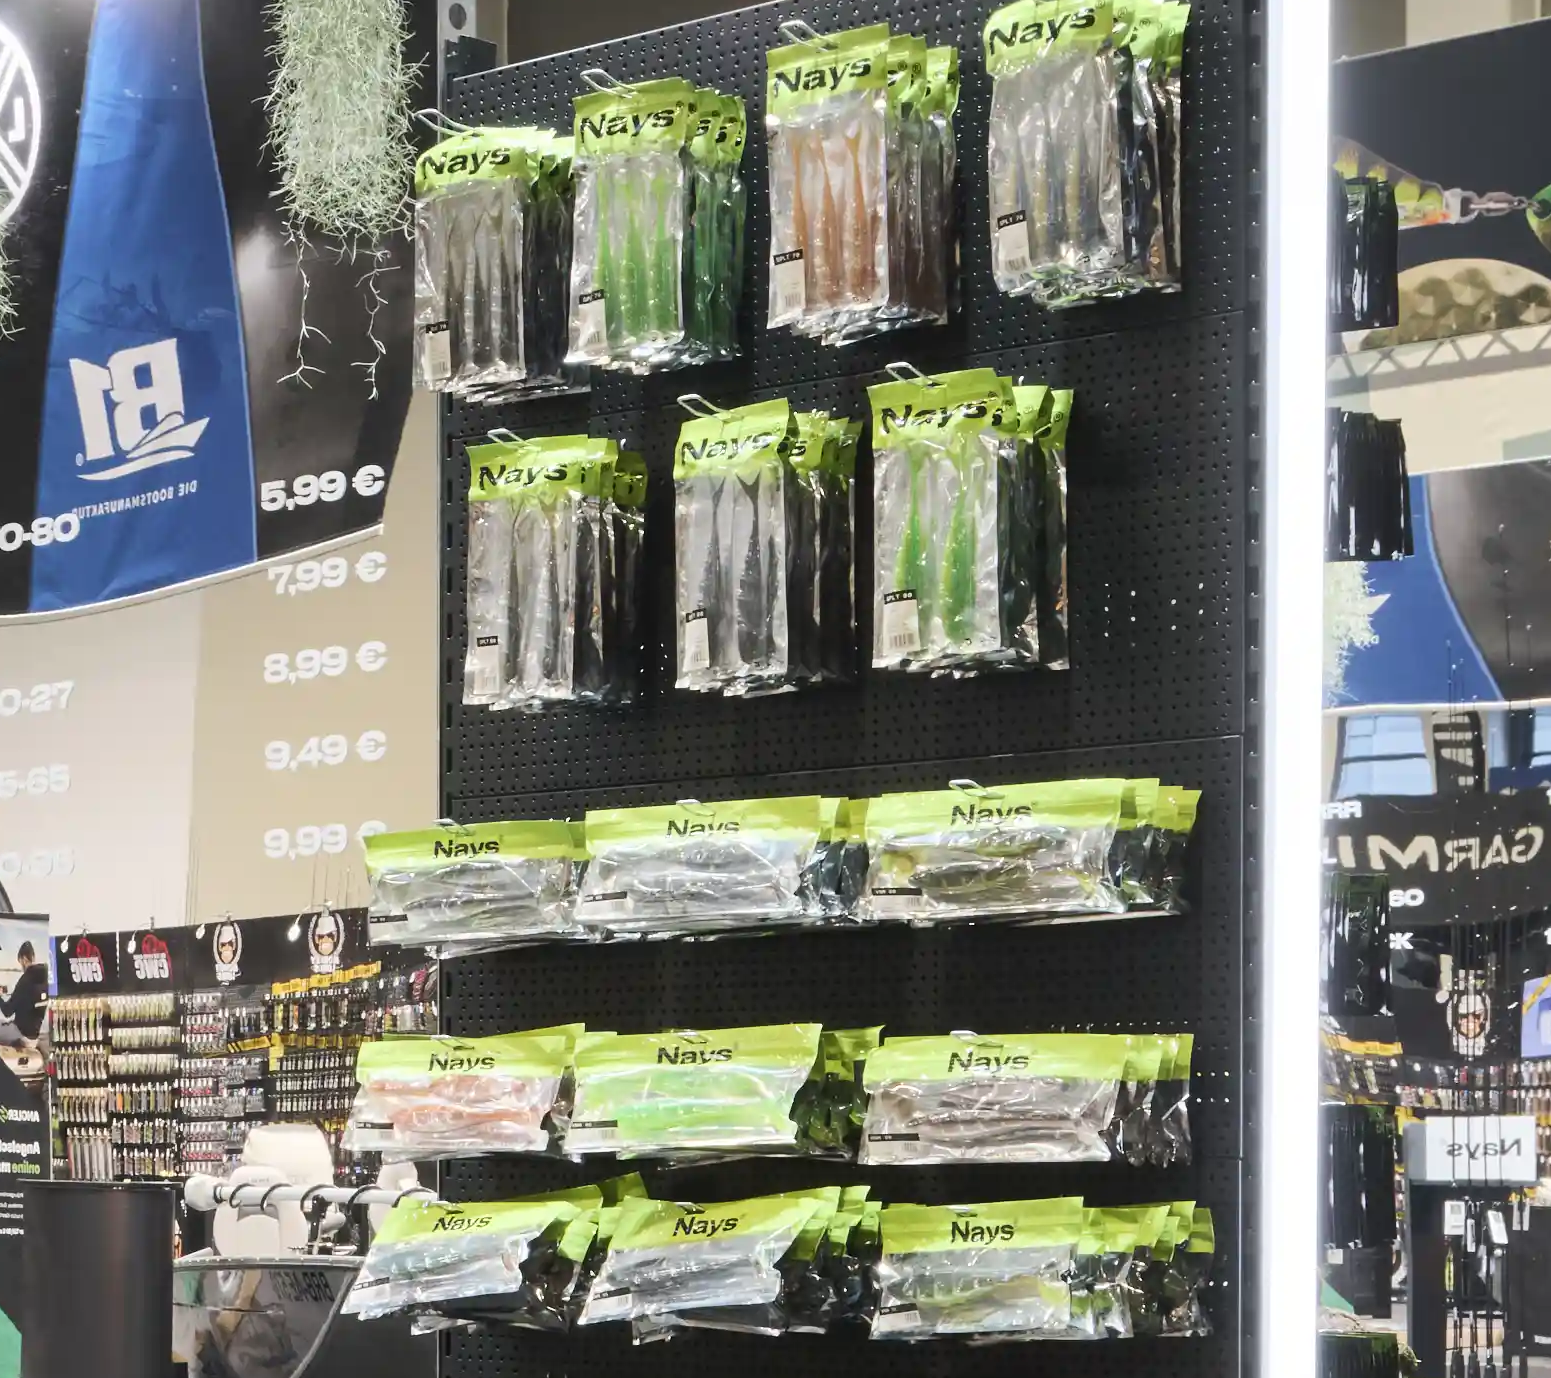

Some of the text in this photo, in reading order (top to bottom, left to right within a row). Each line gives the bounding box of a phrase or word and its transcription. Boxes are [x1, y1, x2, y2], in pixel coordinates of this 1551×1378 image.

[989, 8, 1096, 54] Nays
[773, 56, 872, 96] Nays
[581, 111, 674, 144] Nays
[421, 148, 510, 180] Nays
[881, 399, 988, 433] Nays
[680, 430, 769, 465] Nays
[260, 466, 343, 513] 5,99
[352, 464, 385, 497] €
[479, 462, 567, 491] Nays
[268, 554, 348, 596] 7,99
[356, 552, 387, 583] €
[263, 647, 347, 686] 8,99
[354, 641, 388, 672] €
[264, 736, 348, 773] 9,49
[355, 729, 388, 762] €
[666, 819, 740, 838] Nays
[951, 803, 1033, 825] Nays
[263, 826, 347, 861] 9,99
[433, 839, 500, 859] Nays
[429, 1053, 495, 1071] Nays
[657, 1047, 732, 1065] Nays
[947, 1052, 1029, 1073] Nays
[432, 1213, 492, 1232] Nays
[672, 1215, 740, 1236] Nays
[951, 1221, 1015, 1244] Nays
